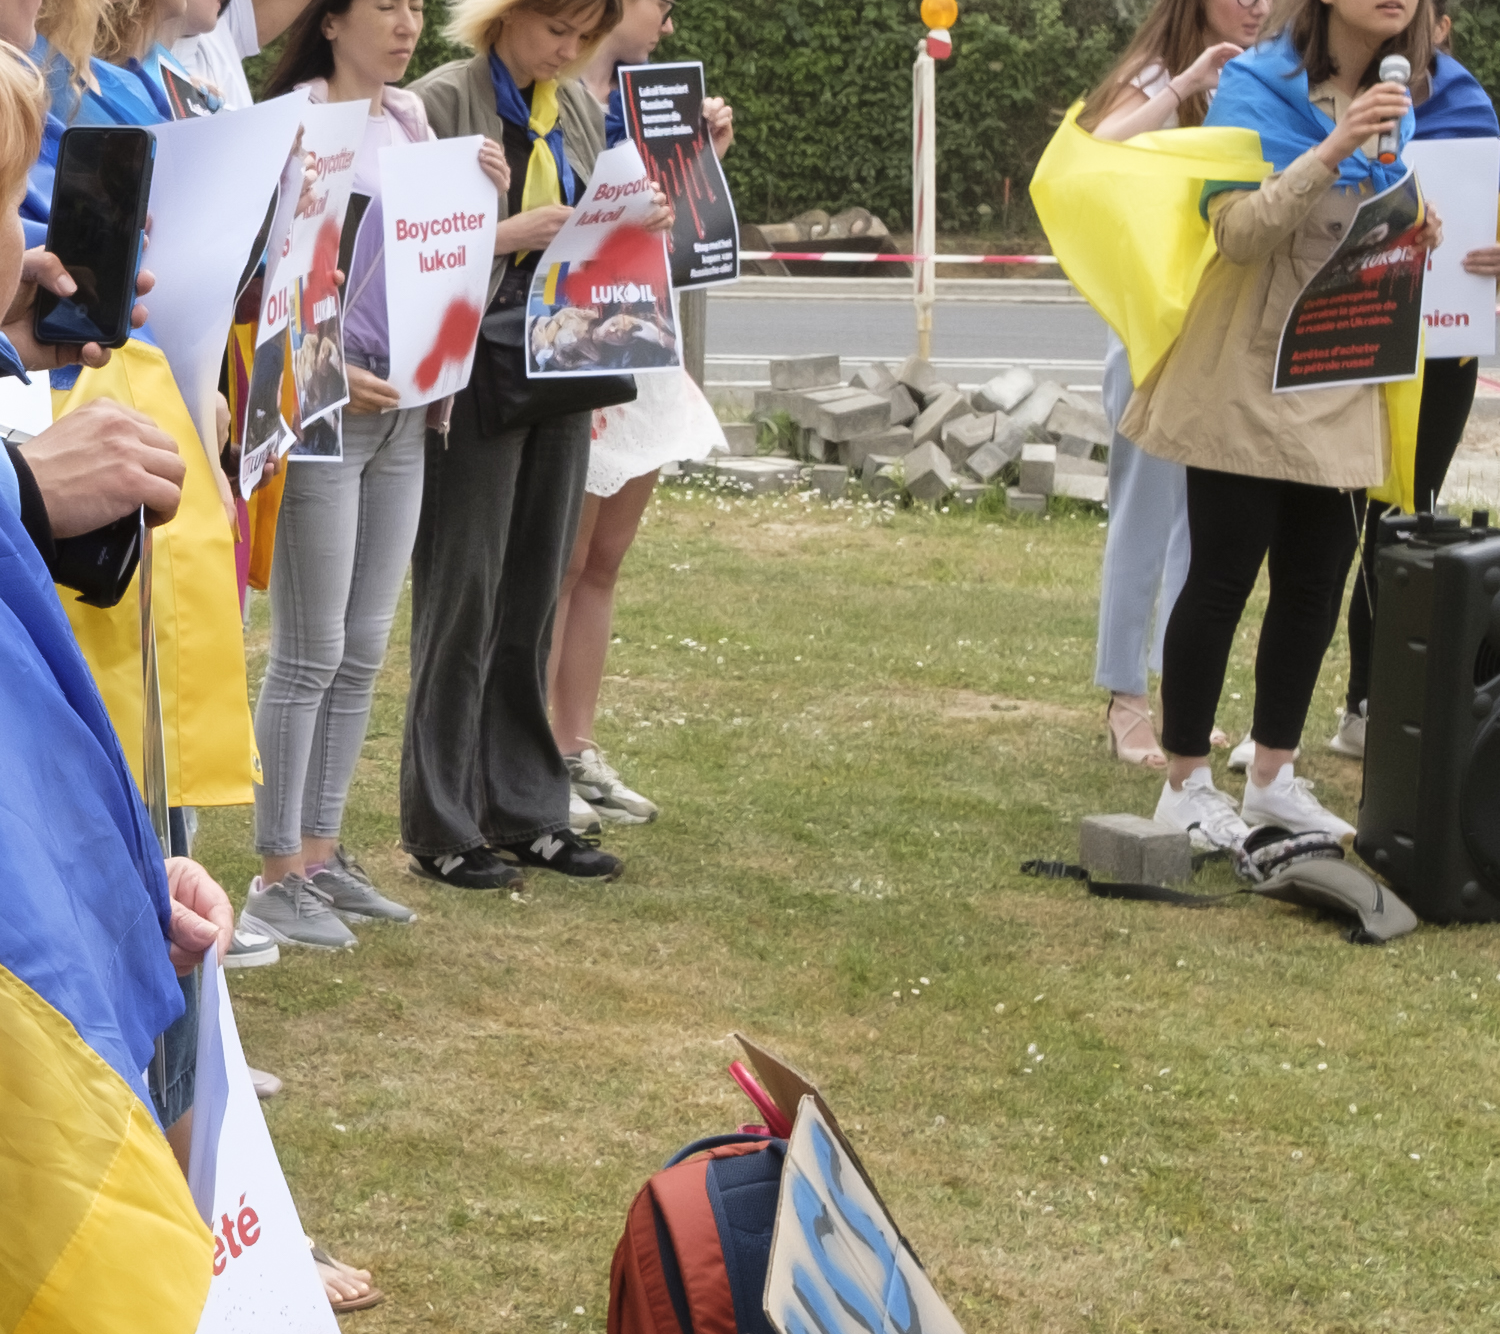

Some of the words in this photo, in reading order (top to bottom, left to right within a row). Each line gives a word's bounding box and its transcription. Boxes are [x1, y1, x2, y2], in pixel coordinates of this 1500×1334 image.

[395, 212, 485, 243] Boycotter
[575, 205, 627, 227] lukoil
[418, 245, 467, 273] lukoil
[591, 280, 657, 304] LUKOIL
